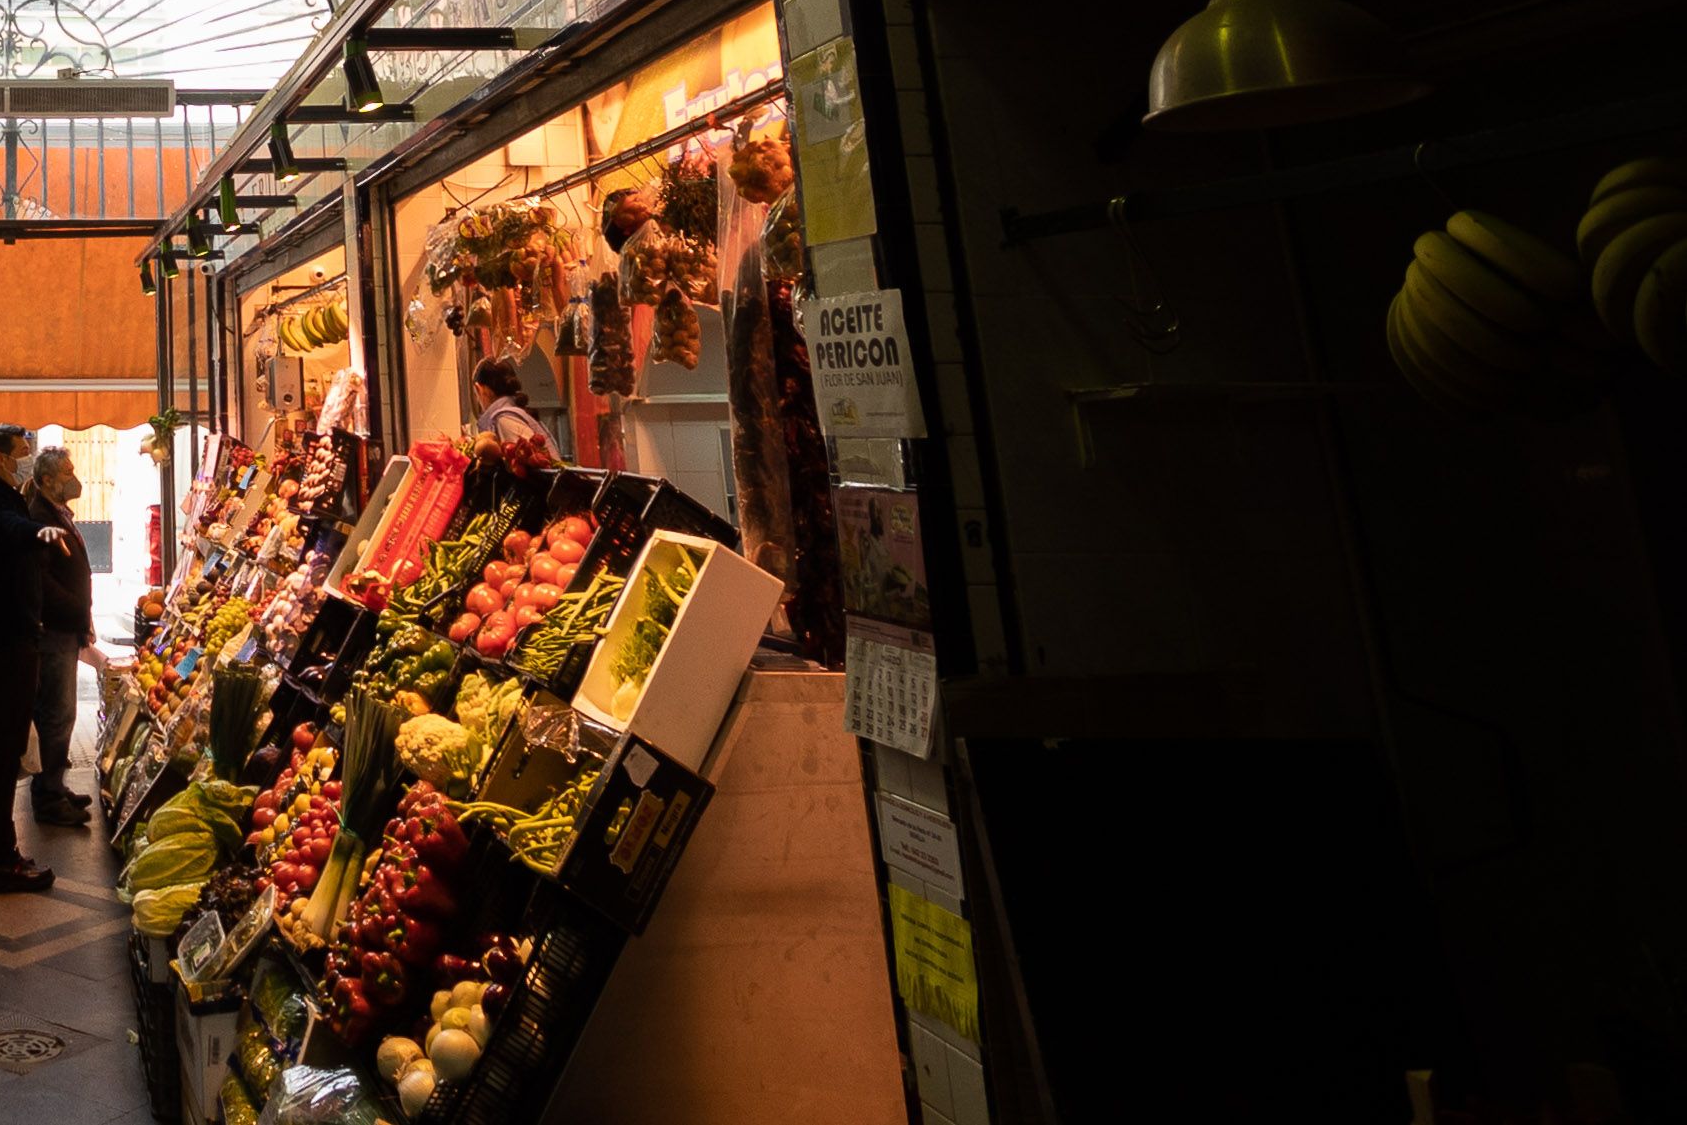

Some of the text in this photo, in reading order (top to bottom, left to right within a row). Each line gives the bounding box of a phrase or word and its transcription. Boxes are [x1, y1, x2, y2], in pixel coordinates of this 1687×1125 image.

[820, 303, 884, 336] ACEITE
[815, 337, 900, 369] PERICON
[856, 371, 873, 386] SAN
